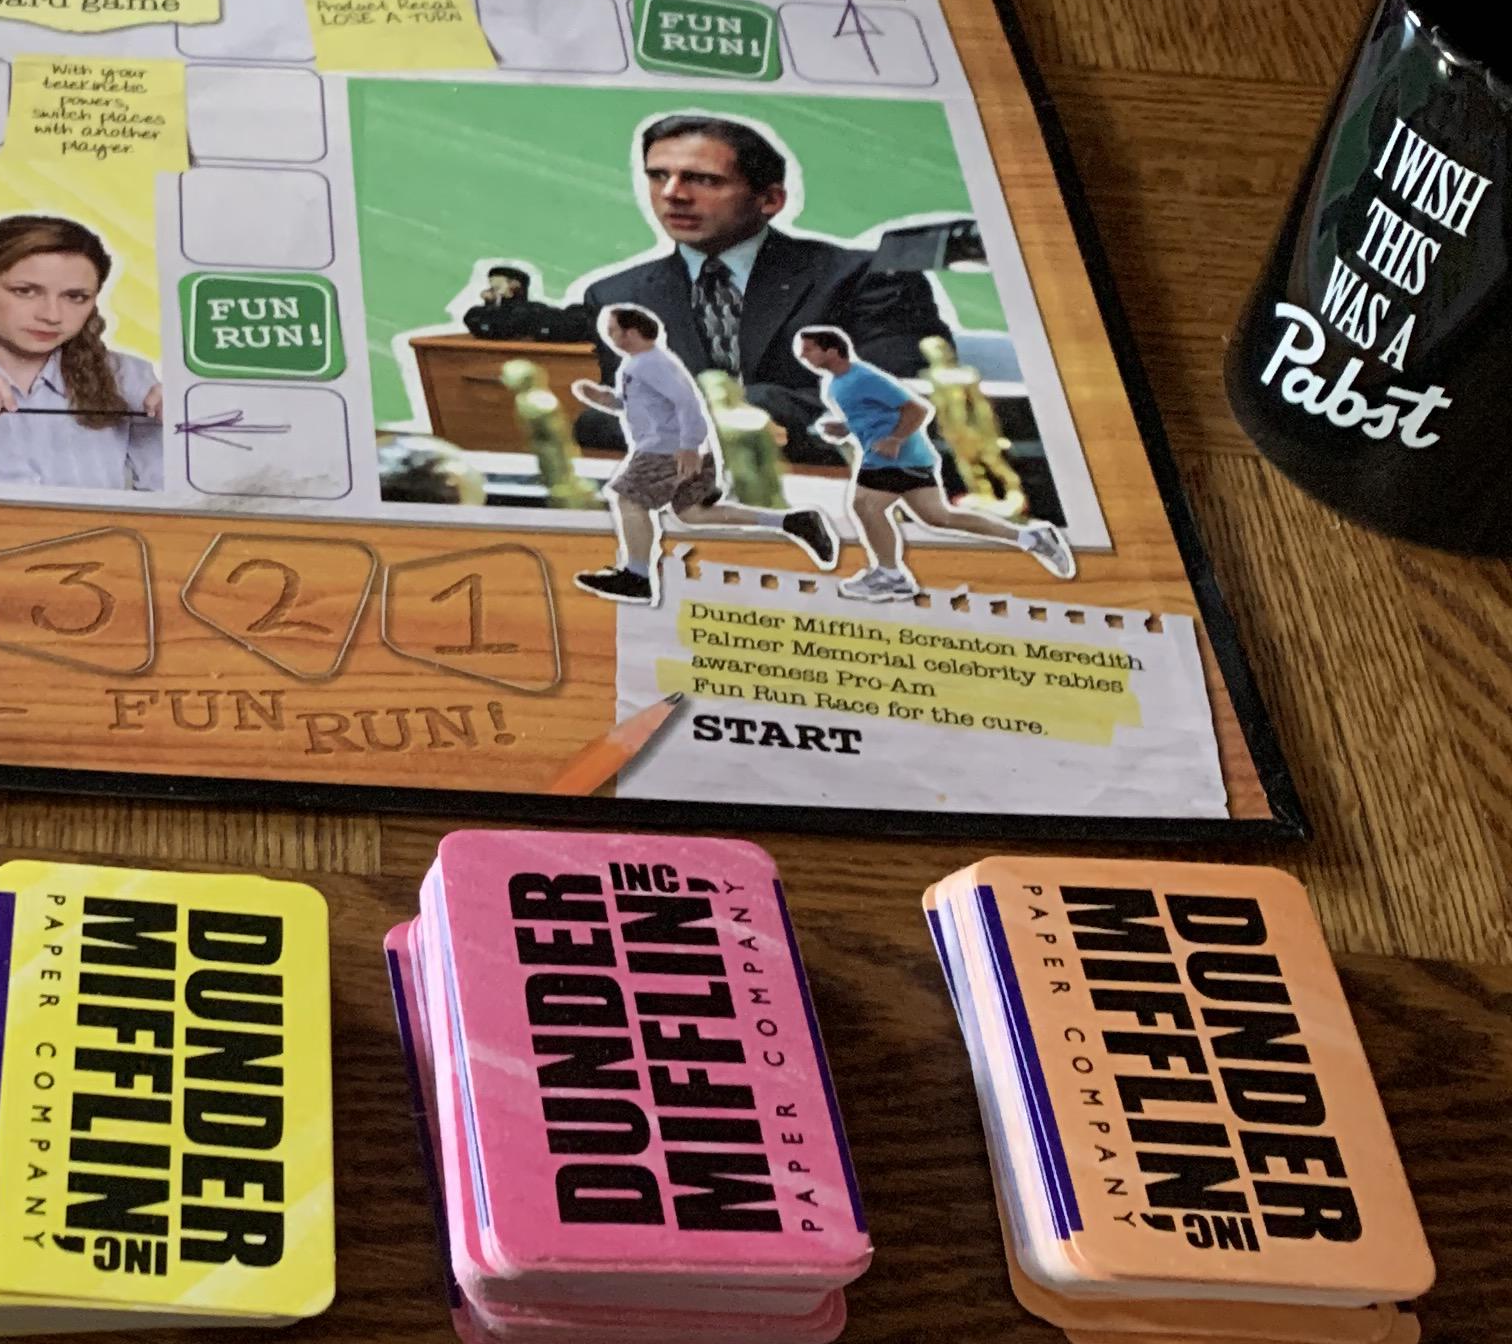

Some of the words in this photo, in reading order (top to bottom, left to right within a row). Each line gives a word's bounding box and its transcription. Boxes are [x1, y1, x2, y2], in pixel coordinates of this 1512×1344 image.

[320, 12, 374, 27] LOSE
[386, 11, 403, 25] A
[408, 12, 463, 25] TURN
[658, 11, 742, 35] FUN
[660, 32, 761, 57] RUN!
[1373, 118, 1406, 179] I
[1389, 126, 1493, 238] WISH
[1356, 197, 1441, 297] THIS
[206, 295, 300, 321] FUN
[212, 323, 323, 349] RUN!
[1319, 255, 1391, 352] WAS
[1379, 313, 1417, 374] A
[1259, 301, 1453, 450] Pabst
[24, 560, 117, 636] 3
[226, 558, 332, 635] 2
[429, 573, 519, 655] 1
[689, 603, 786, 630] Dunder
[793, 614, 892, 644] Mifflin,
[898, 627, 1017, 658] Scranton
[1025, 640, 1145, 673] Meredith
[691, 628, 785, 655] Palmer
[791, 639, 917, 672] Memorial
[923, 655, 1038, 688] celebrity
[1043, 669, 1126, 695] rabies
[691, 654, 831, 685] awareness
[835, 668, 938, 699] Pro-Am
[691, 676, 745, 700] Fun
[753, 684, 809, 708] Run
[814, 691, 881, 717] Race
[886, 698, 926, 722] for
[930, 704, 976, 729] the
[982, 713, 1049, 737] cure.
[105, 688, 286, 733] FUN
[295, 699, 518, 756] RUN!
[691, 713, 864, 757] START
[608, 861, 679, 893] INC
[37, 893, 68, 1010] PAPER
[722, 875, 786, 1067] COMPANY
[508, 870, 667, 1227] DUNDER
[1022, 884, 1074, 997] PAPER
[1061, 1025, 1139, 1230] COMPANY
[1163, 893, 1363, 1243] DUNDER
[180, 908, 286, 1271] DUNDER
[24, 1041, 58, 1250] COMPANY
[775, 1100, 825, 1233] PAPER
[91, 1235, 170, 1277] INC
[1183, 1212, 1262, 1253] INC
